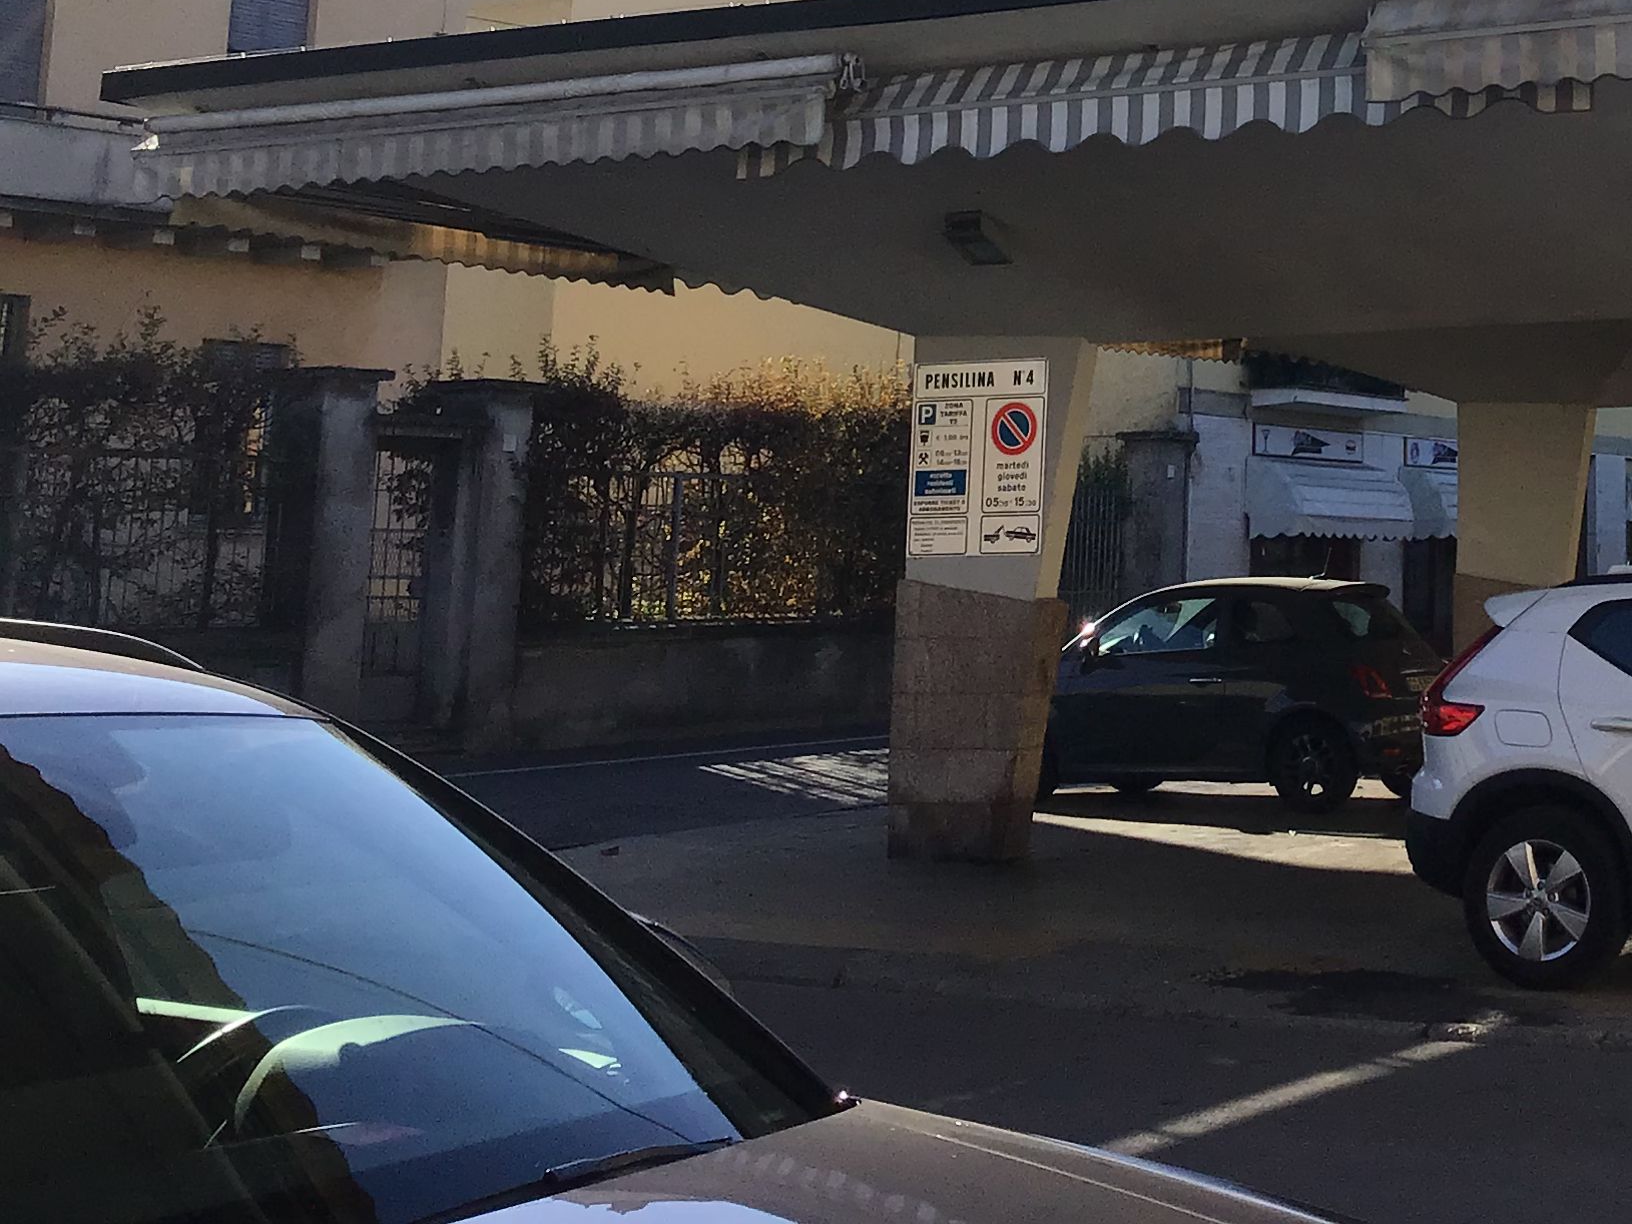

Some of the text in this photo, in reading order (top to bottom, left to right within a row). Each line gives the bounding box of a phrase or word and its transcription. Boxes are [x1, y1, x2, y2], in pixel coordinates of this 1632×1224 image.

[925, 371, 995, 389] PENSILINA
[921, 405, 933, 424] P
[997, 483, 1026, 492] sabato
